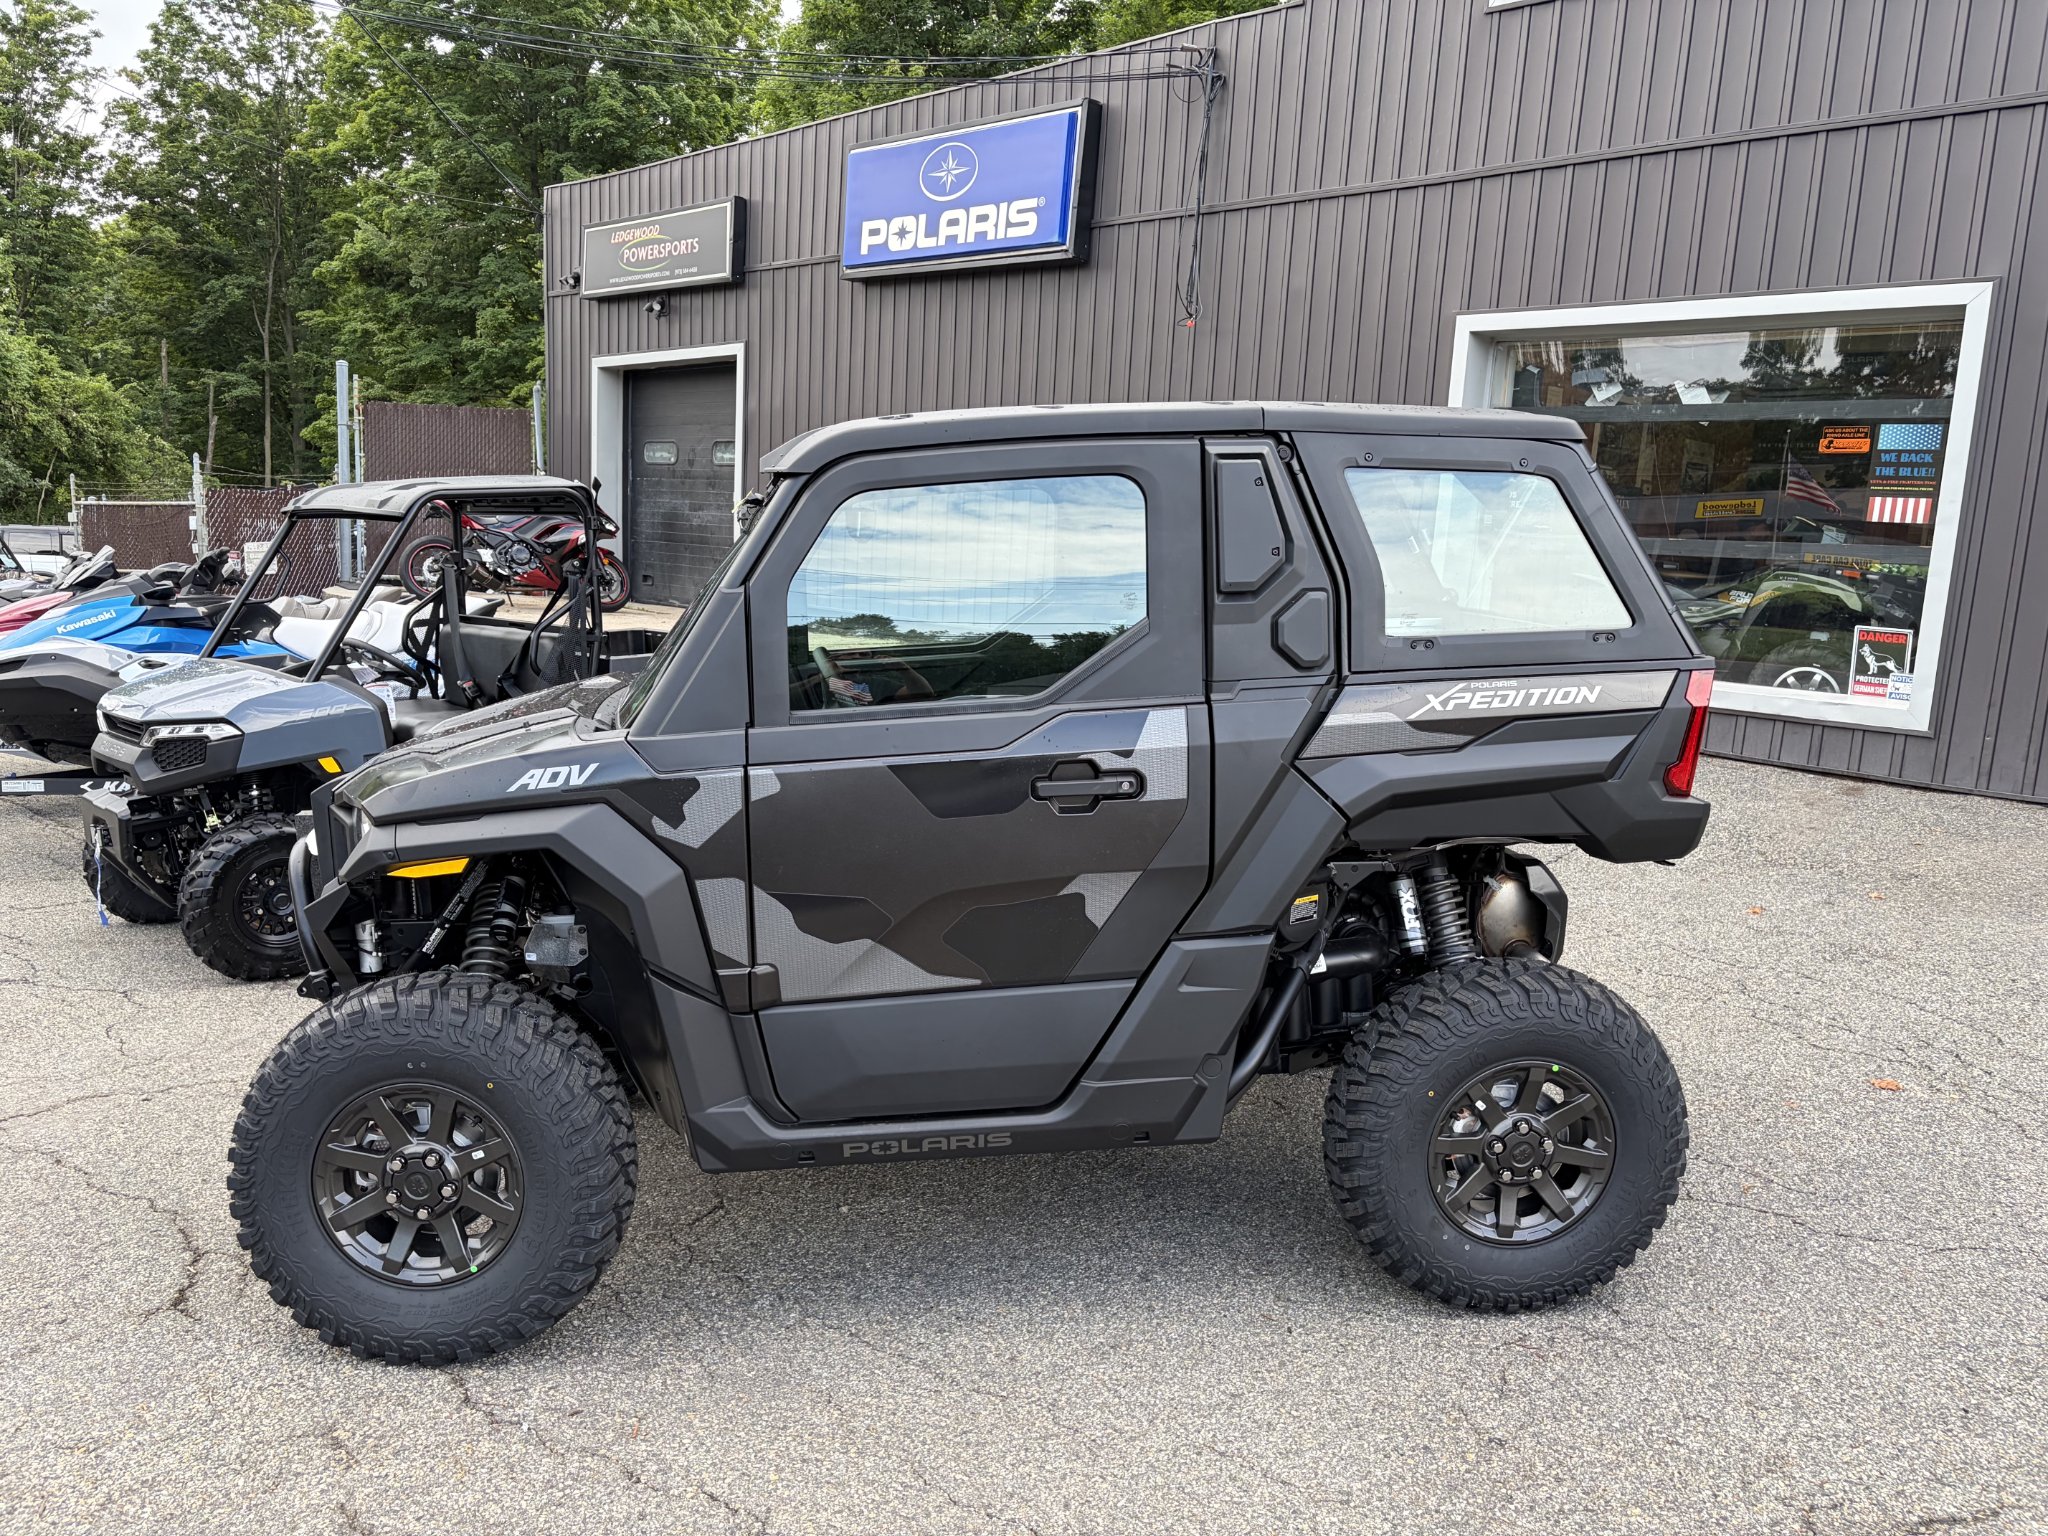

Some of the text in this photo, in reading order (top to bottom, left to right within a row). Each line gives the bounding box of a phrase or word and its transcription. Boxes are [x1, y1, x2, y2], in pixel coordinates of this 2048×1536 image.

[610, 224, 660, 244] LEDGEWOOD
[859, 197, 1038, 256] POLARIS
[622, 237, 699, 263] POWERSPORTS
[1880, 452, 1934, 463] WE BACK
[1875, 466, 1936, 477] THE BLUE!!
[56, 609, 117, 634] Kawasaki
[1859, 631, 1907, 643] DANGER
[1470, 680, 1518, 689] POLARIS
[1853, 685, 1874, 694] GERMAN
[1890, 675, 1913, 683] NOTIC
[1406, 682, 1602, 720] XPEDITION
[505, 762, 600, 793] ADV
[1397, 888, 1421, 930] FOX
[842, 1132, 1013, 1158] POLARIS
